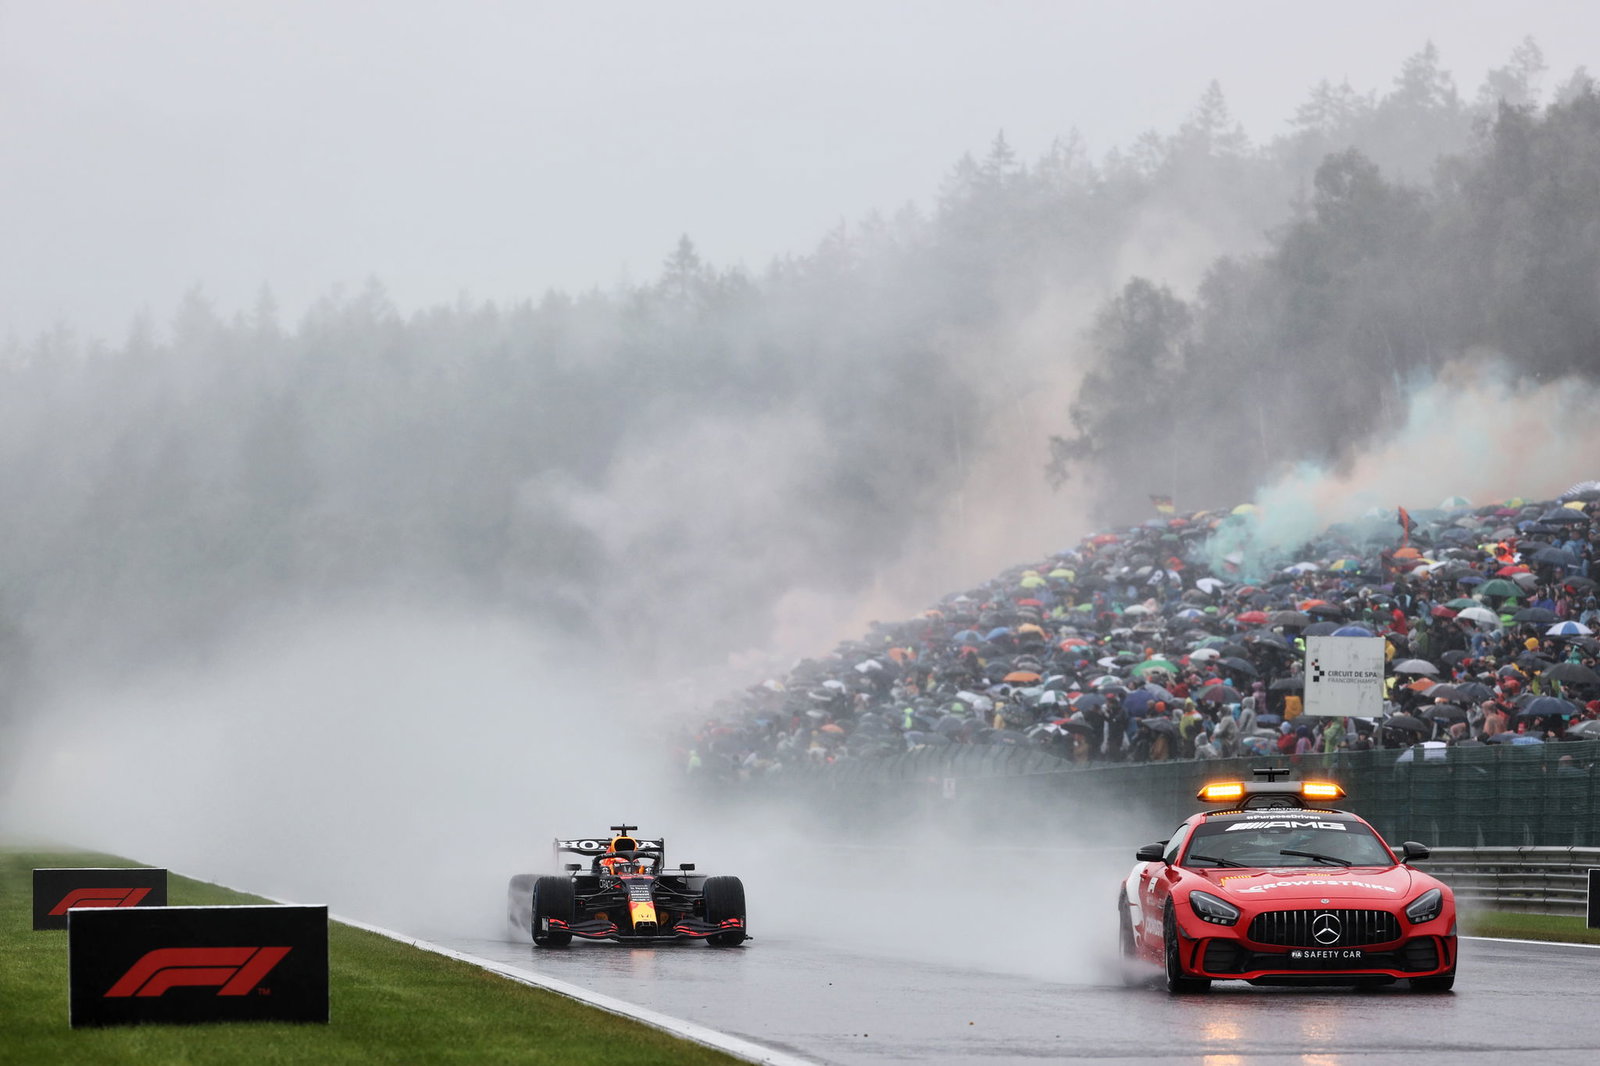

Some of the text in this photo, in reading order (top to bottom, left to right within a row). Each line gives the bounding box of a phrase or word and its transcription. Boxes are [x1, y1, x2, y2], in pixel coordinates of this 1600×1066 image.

[1264, 821, 1346, 831] AMG
[559, 840, 661, 850] HOA
[1237, 880, 1397, 893] CROWDSTRIKE
[1304, 950, 1339, 959] SAFETY
[1342, 950, 1361, 959] CAR
[103, 946, 293, 997] F1
